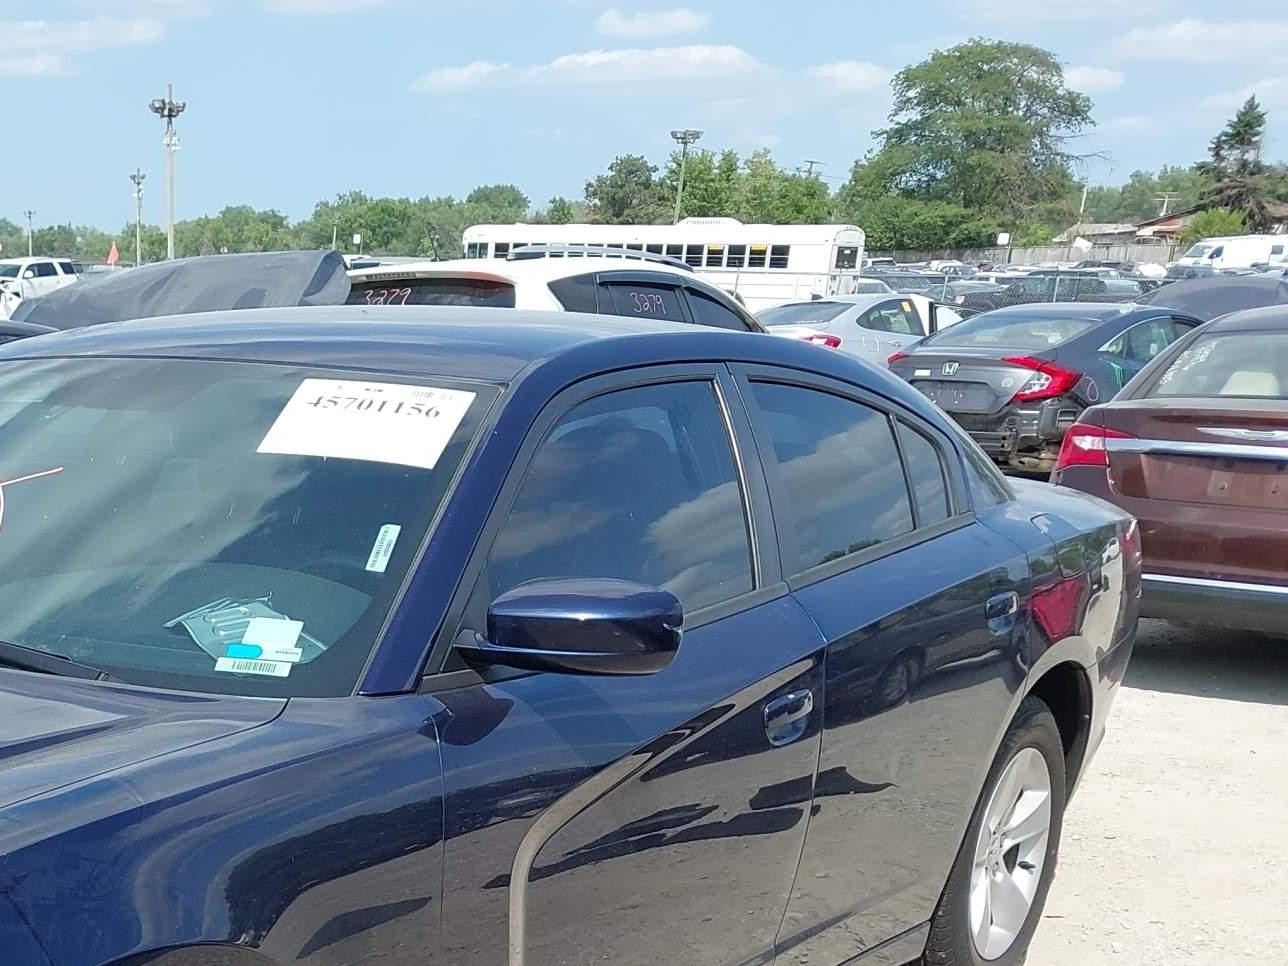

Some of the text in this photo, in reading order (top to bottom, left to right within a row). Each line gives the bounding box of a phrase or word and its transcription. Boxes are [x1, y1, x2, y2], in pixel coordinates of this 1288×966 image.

[363, 287, 412, 306] 3279
[630, 292, 667, 315] 3279
[306, 395, 441, 418] 45701156
